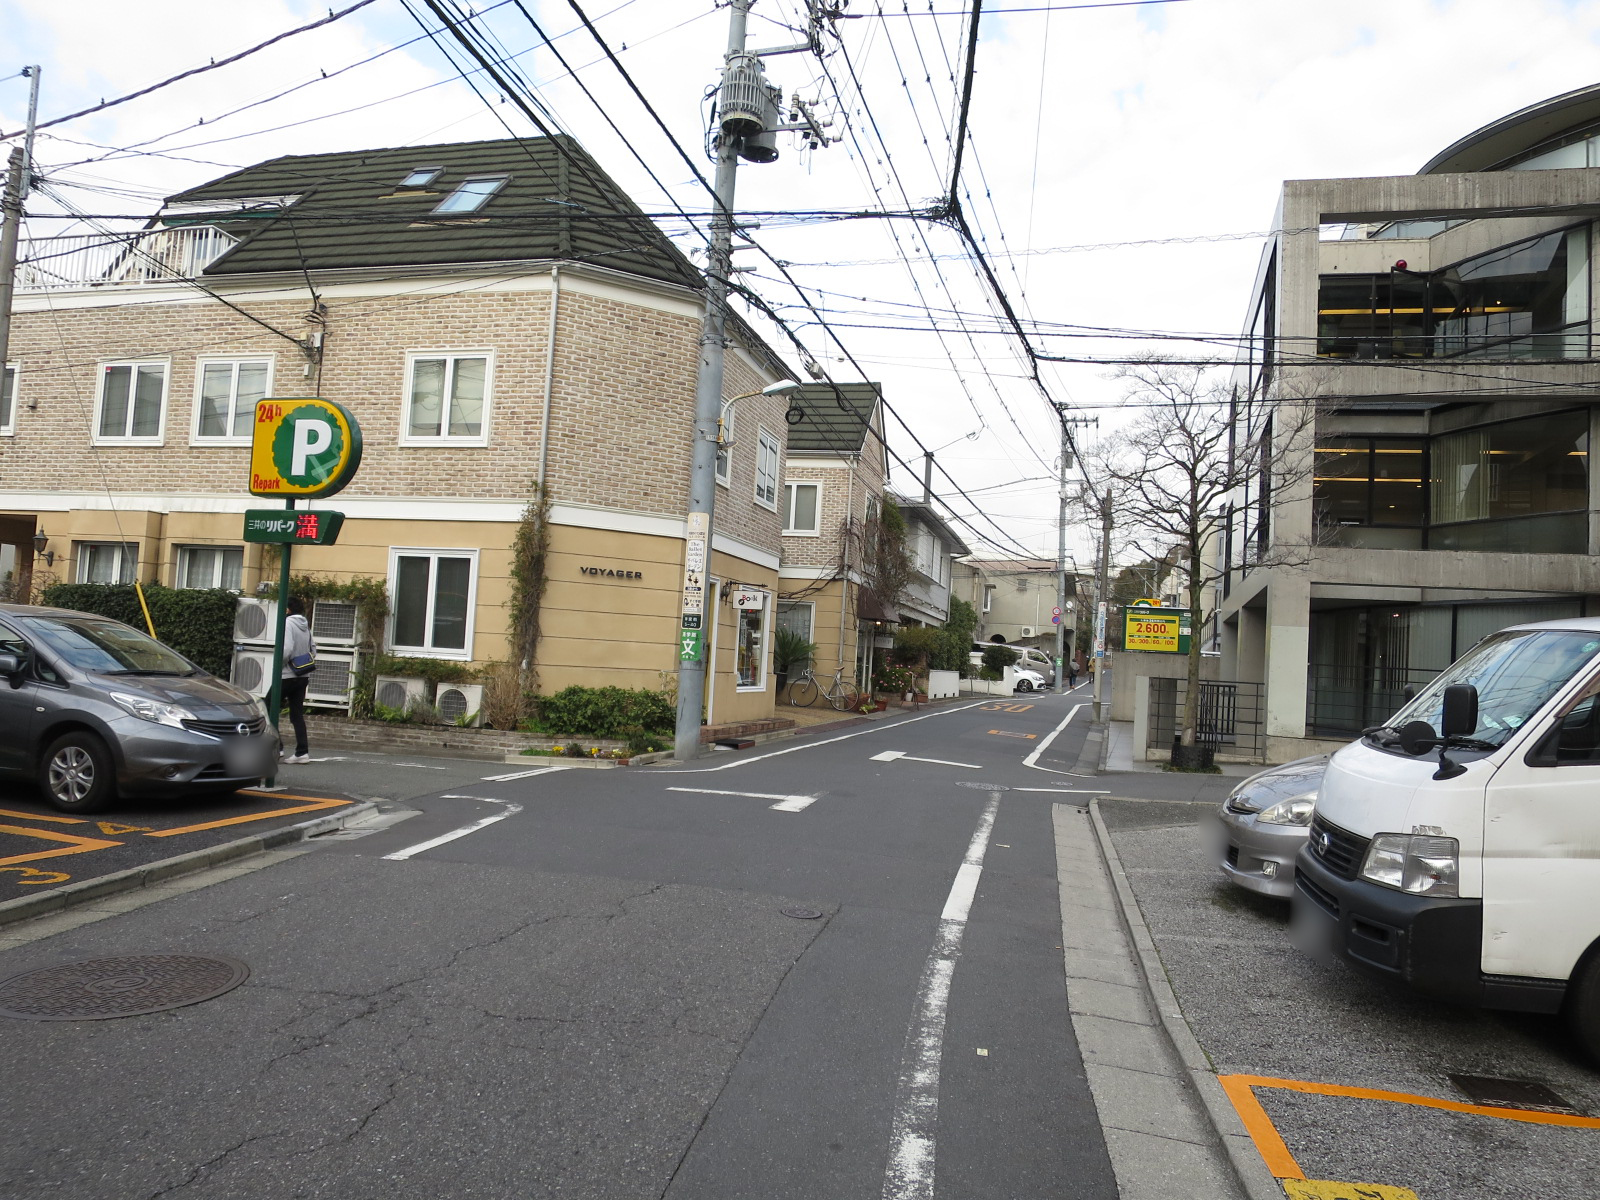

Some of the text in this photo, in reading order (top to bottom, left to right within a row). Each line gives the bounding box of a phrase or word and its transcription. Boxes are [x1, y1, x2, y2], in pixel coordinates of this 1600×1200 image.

[258, 404, 282, 423] 24h
[291, 419, 332, 476] P
[253, 474, 280, 491] Repark
[248, 514, 319, 539] 三井のリパーク 満
[580, 566, 642, 580] VOYAGER
[681, 638, 696, 655] 文
[979, 702, 1035, 713] 30
